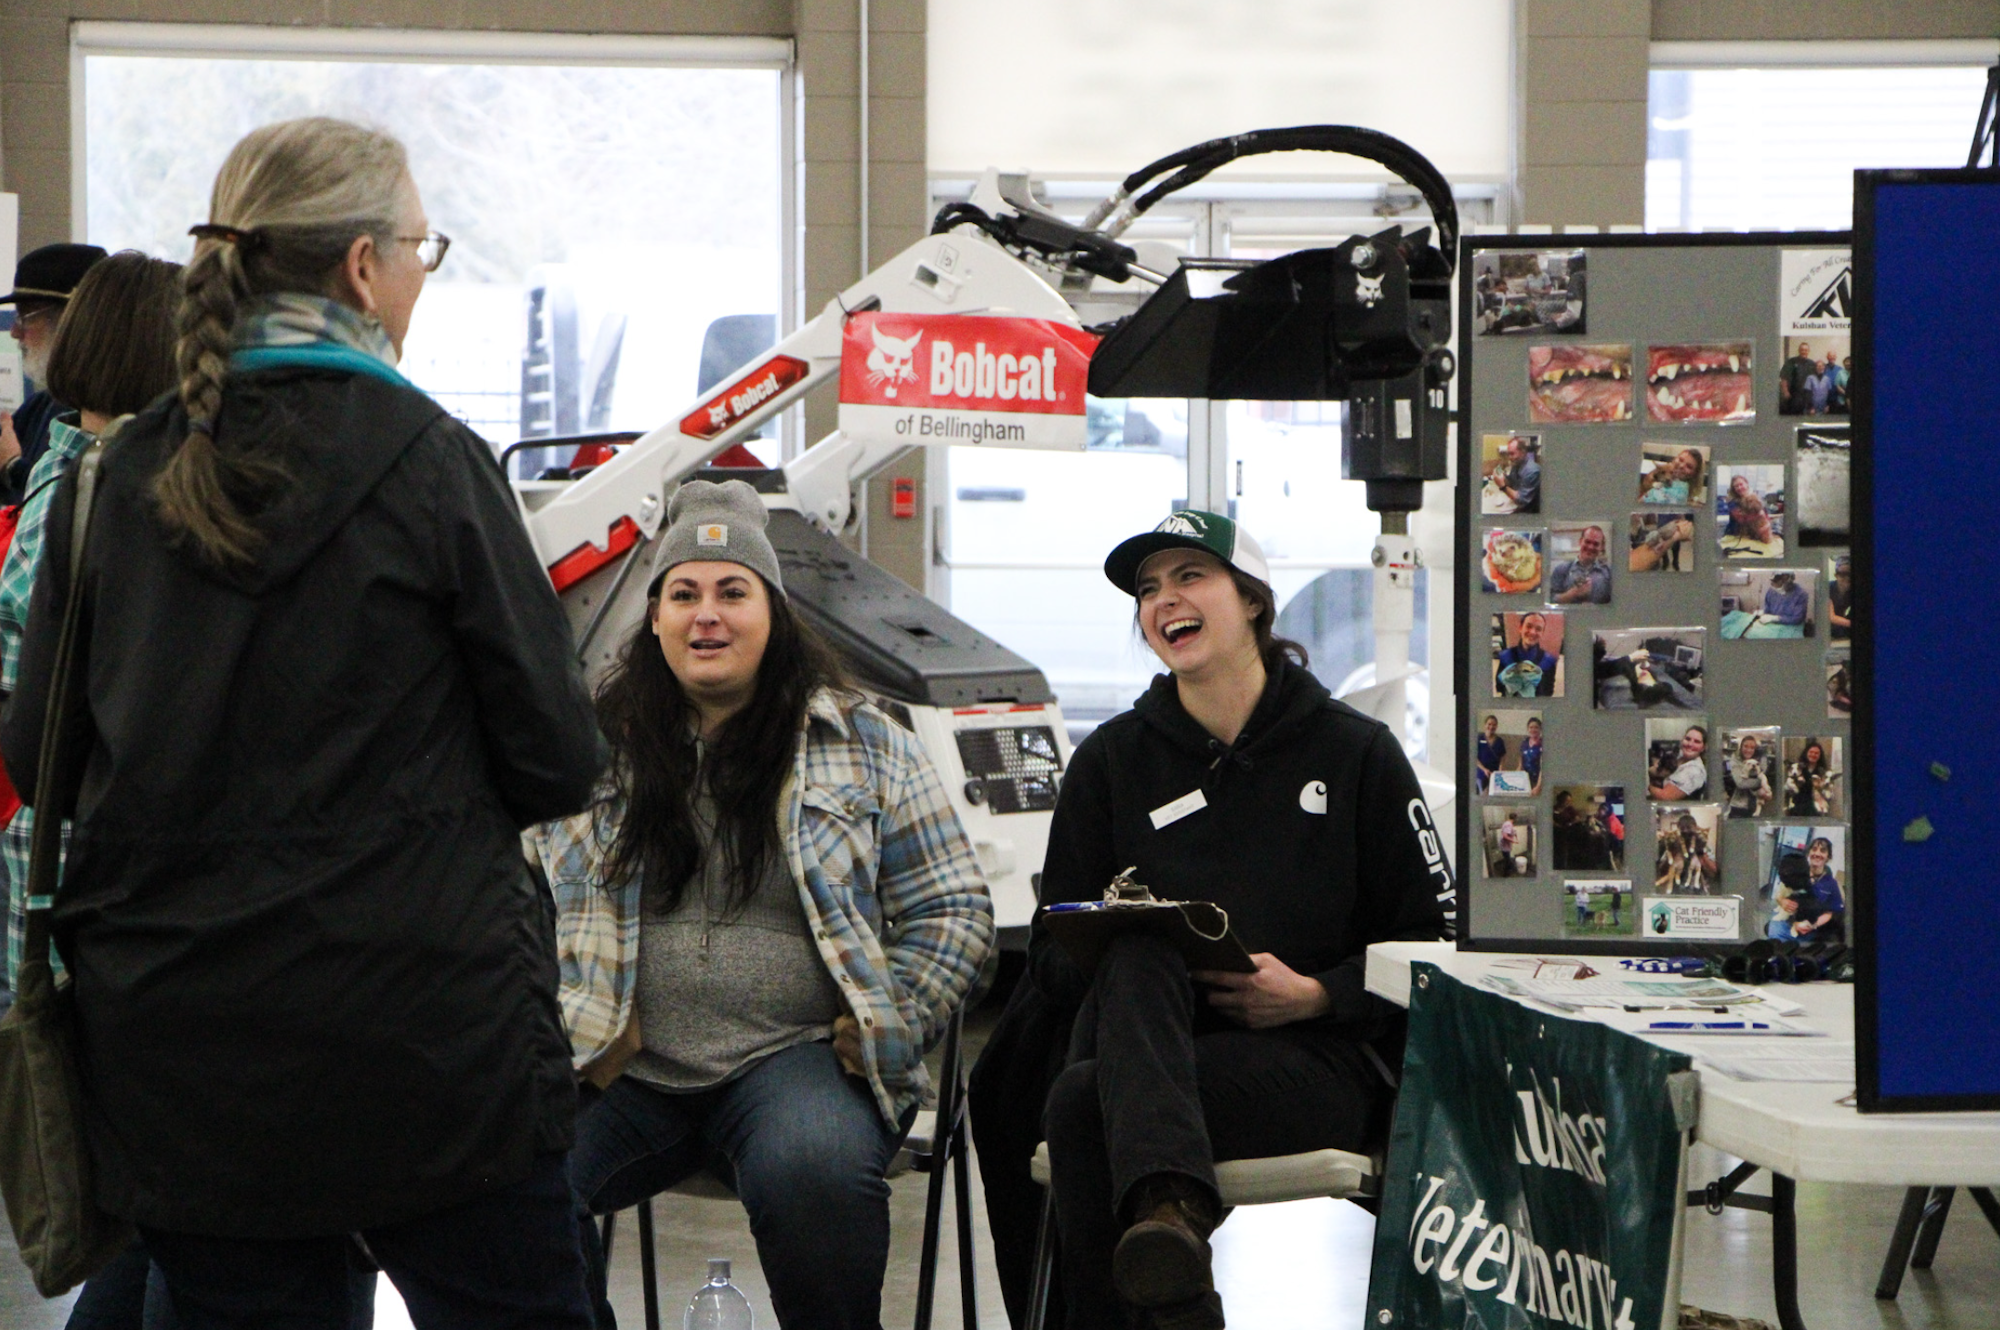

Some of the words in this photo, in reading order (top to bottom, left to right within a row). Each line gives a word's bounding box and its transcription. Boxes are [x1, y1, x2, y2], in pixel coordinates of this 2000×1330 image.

[1792, 321, 1827, 329] Kulshan
[930, 340, 1057, 401] Bobcat
[730, 372, 779, 417] Bobcat
[1428, 388, 1444, 409] 10
[895, 414, 914, 435] of
[920, 415, 1025, 444] Bellingham
[1675, 906, 1689, 916] Cat
[1691, 907, 1728, 919] Friendly
[1675, 915, 1709, 925] Practice
